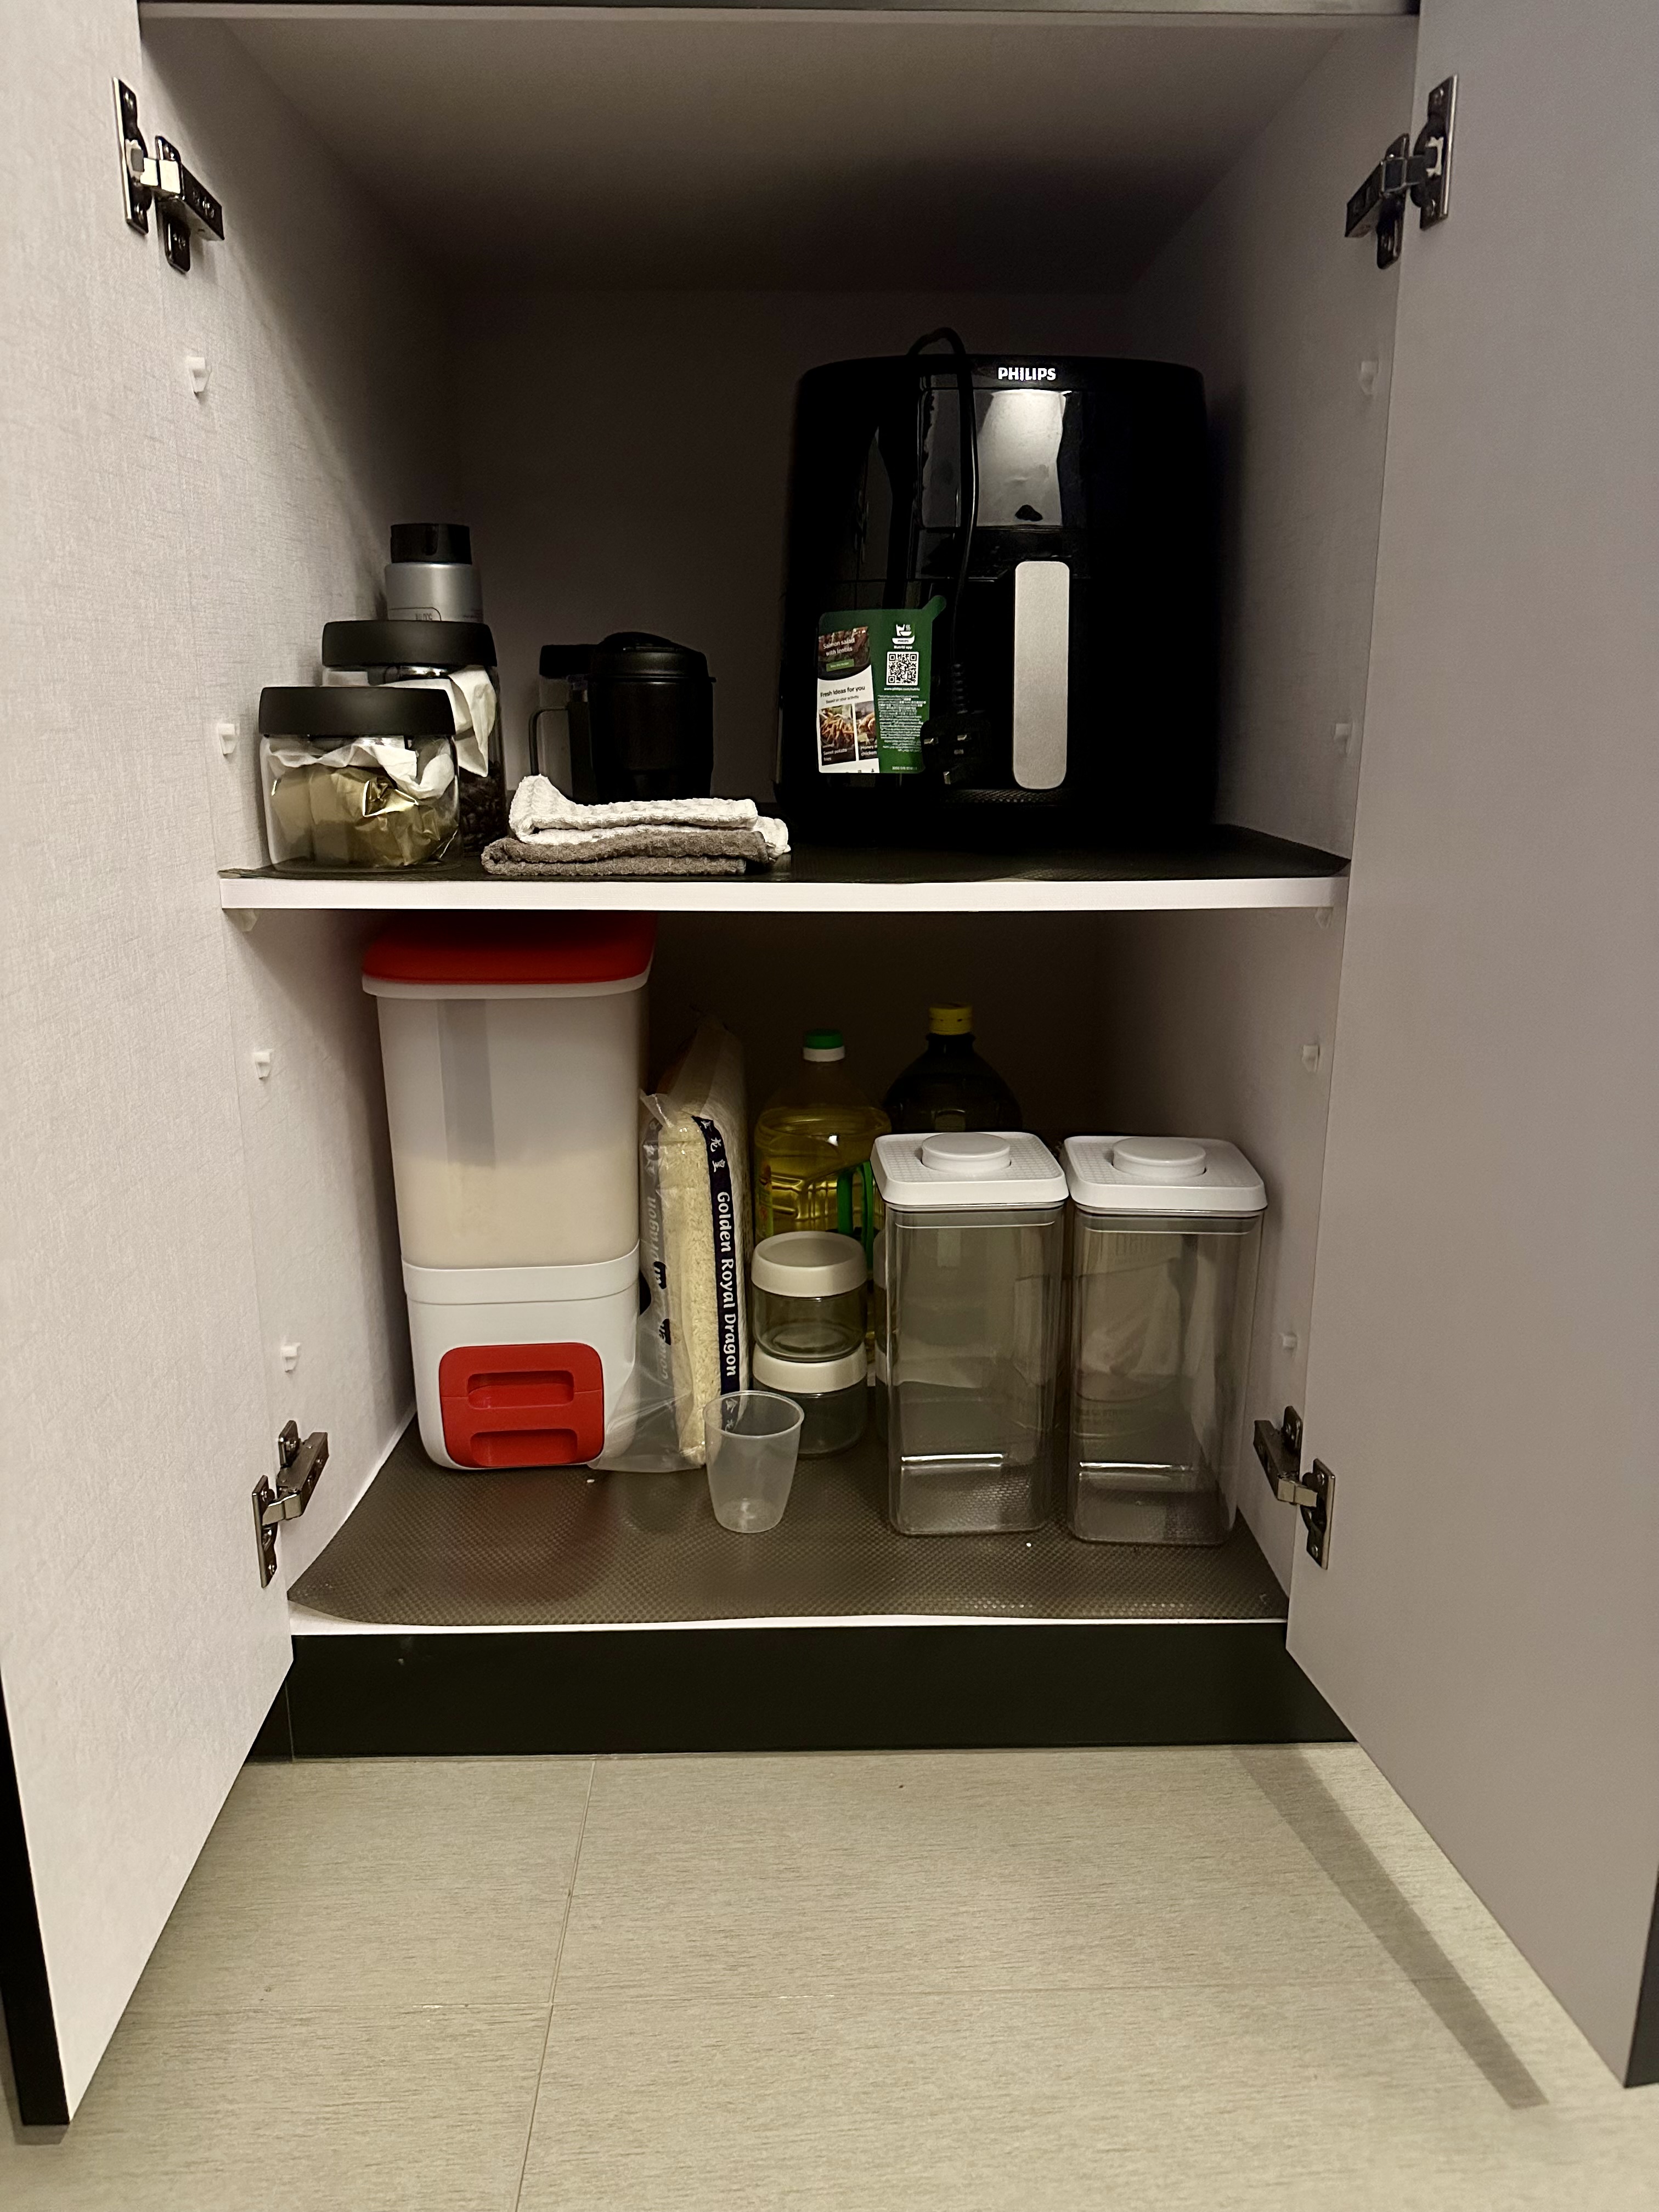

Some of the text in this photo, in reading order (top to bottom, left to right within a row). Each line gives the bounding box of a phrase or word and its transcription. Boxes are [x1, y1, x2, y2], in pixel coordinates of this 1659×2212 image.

[998, 367, 1057, 381] PHILIPS
[841, 637, 855, 645] salad
[837, 646, 853, 654] lentils
[717, 1191, 736, 1377] Golden Royal Dragon
